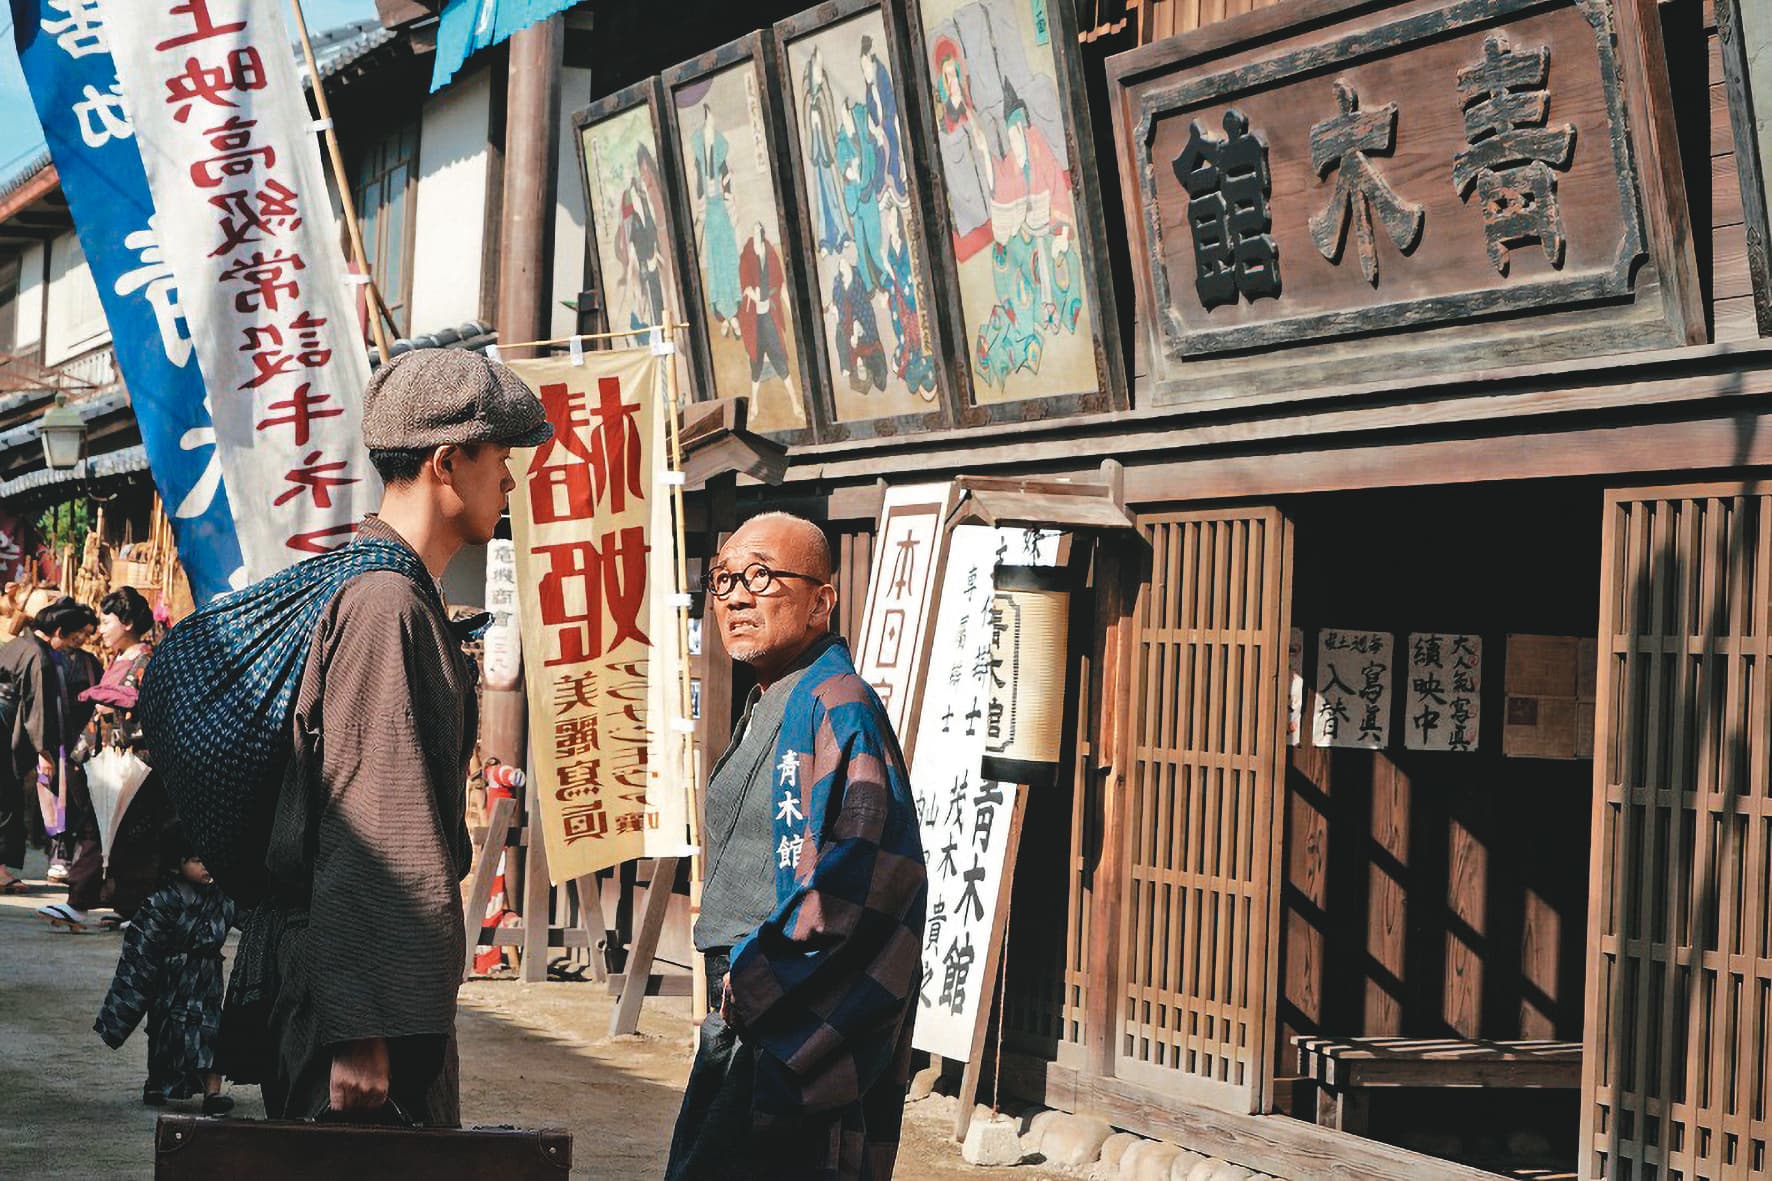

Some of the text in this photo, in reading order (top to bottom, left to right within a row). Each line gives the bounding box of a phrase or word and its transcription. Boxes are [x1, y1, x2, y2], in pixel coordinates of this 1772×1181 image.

[1172, 30, 1578, 312] 青木館
[776, 749, 804, 870] 青木館
[939, 778, 1004, 1018] 青木館
